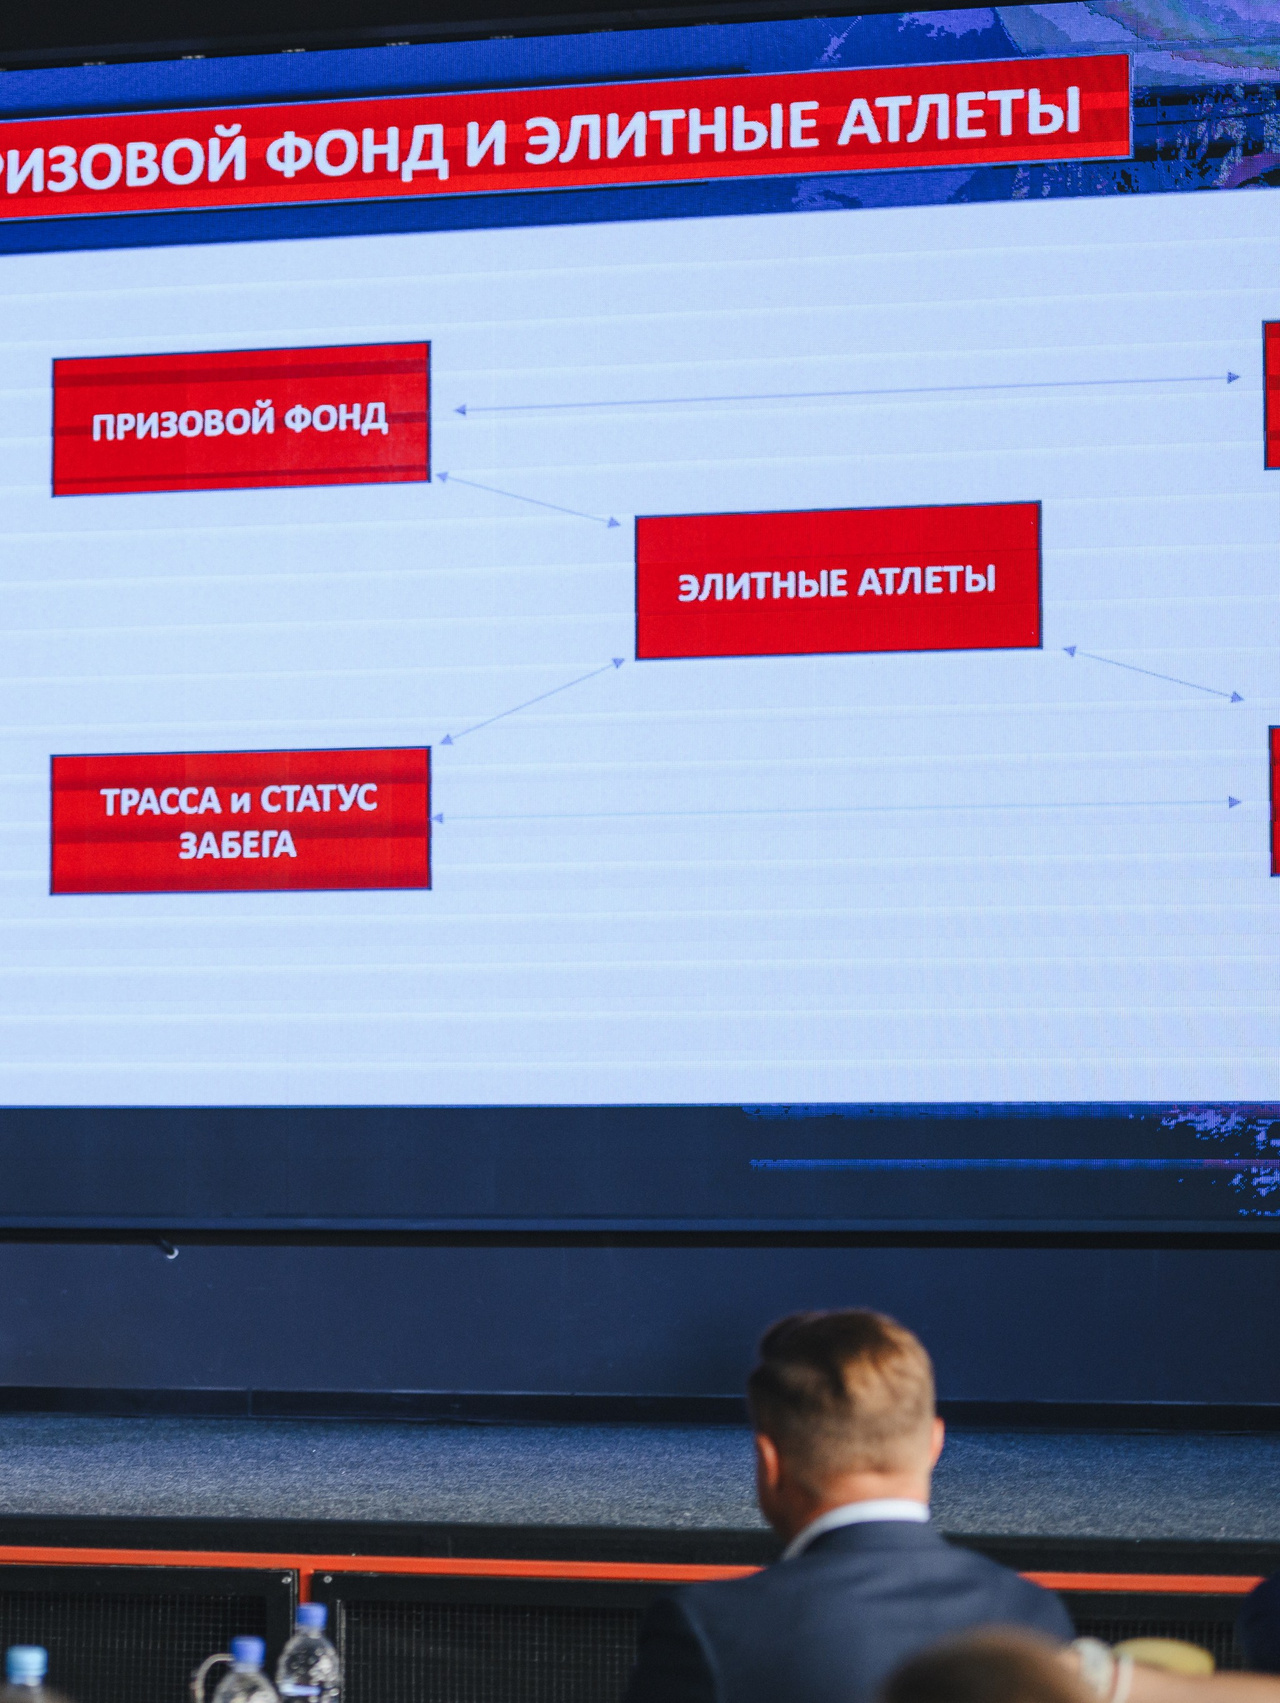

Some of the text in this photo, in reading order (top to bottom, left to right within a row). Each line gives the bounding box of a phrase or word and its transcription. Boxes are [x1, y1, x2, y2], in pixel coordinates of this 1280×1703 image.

[266, 123, 449, 183] ФОНД
[466, 119, 506, 167] И
[525, 101, 820, 165] ЭЛИТНЫЕ
[837, 85, 1080, 146] АТЛЕТЫ
[92, 398, 389, 442] ПРИЗОВОЙ ФОНД
[678, 564, 997, 602] ЭЛИТНЫЕ АТЛЕТЫ
[99, 783, 378, 816] ТРАССА и СТАТУС
[179, 830, 297, 860] ЗАБЕГА
